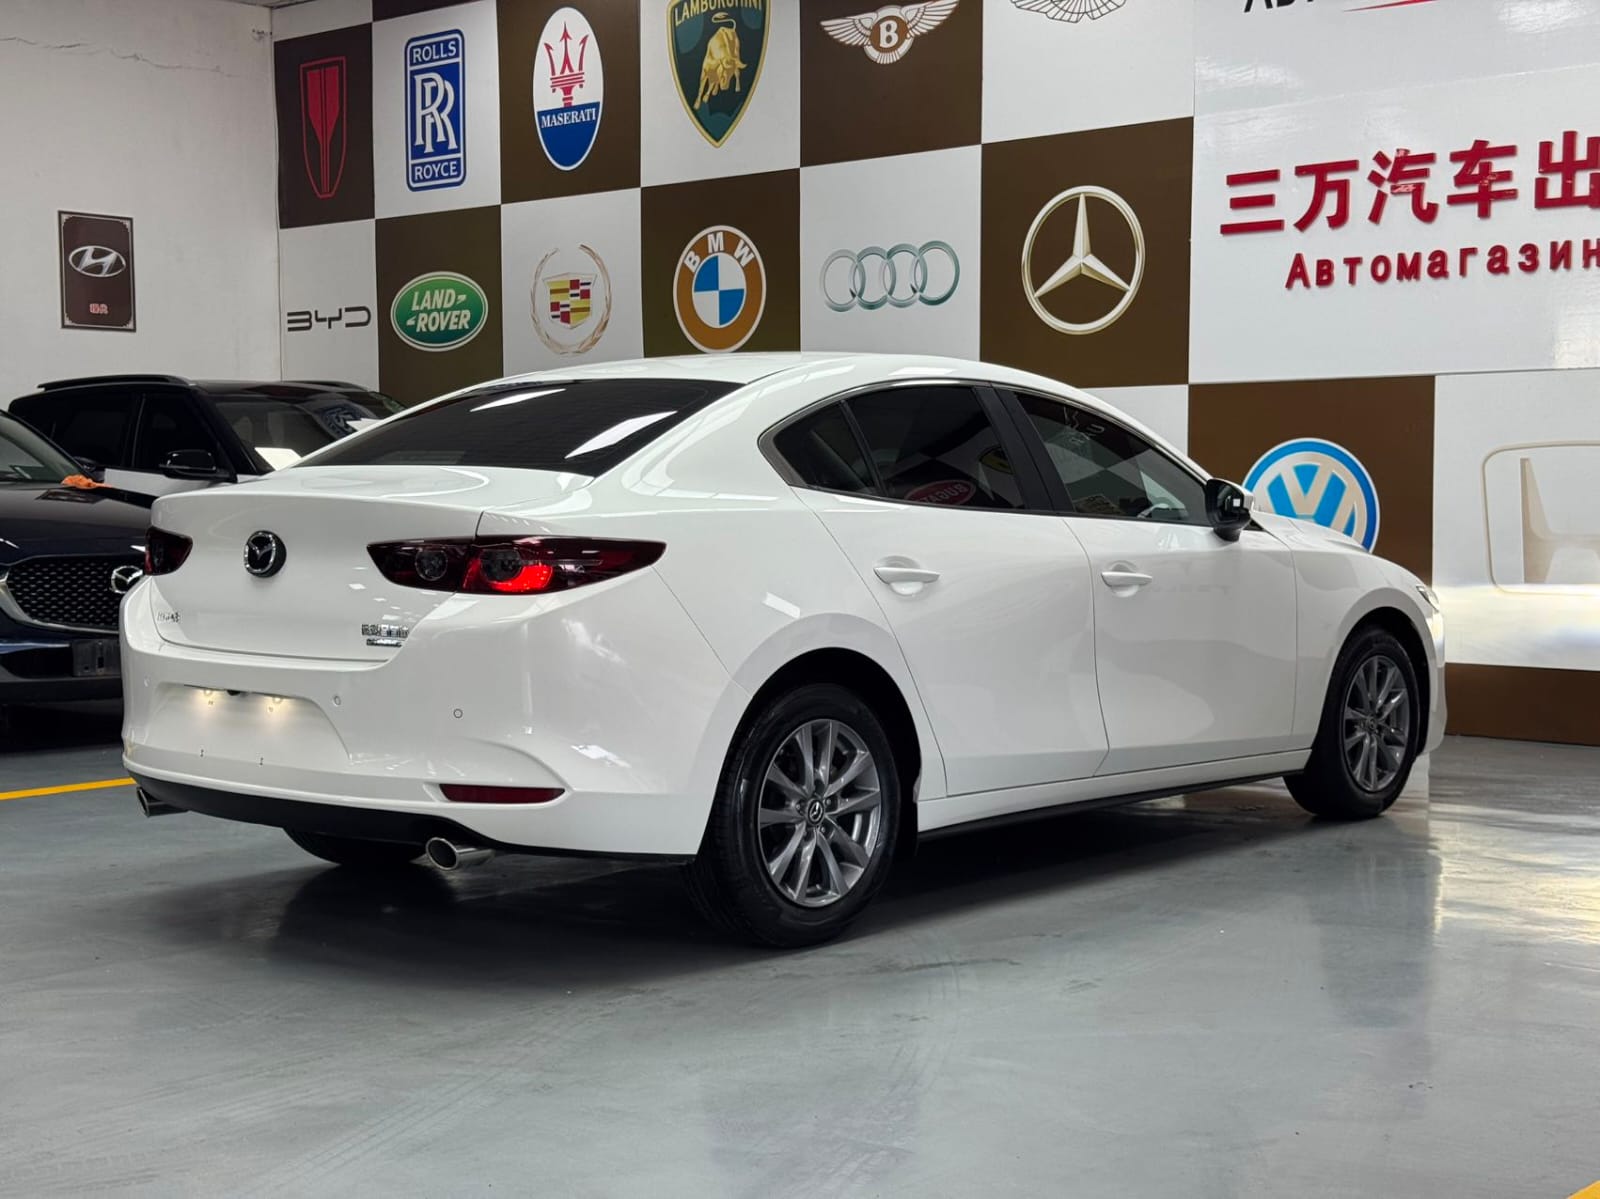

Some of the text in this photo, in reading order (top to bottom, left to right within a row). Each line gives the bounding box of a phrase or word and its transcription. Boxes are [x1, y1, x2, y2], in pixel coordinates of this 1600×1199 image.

[412, 43, 457, 63] ROLLS
[540, 107, 597, 129] MASERATI
[413, 160, 458, 181] ROYCE
[1219, 130, 1600, 236] 三万汽车出
[683, 231, 755, 274] BMW
[1284, 237, 1600, 291] Автомагазин
[286, 305, 372, 332] BYD
